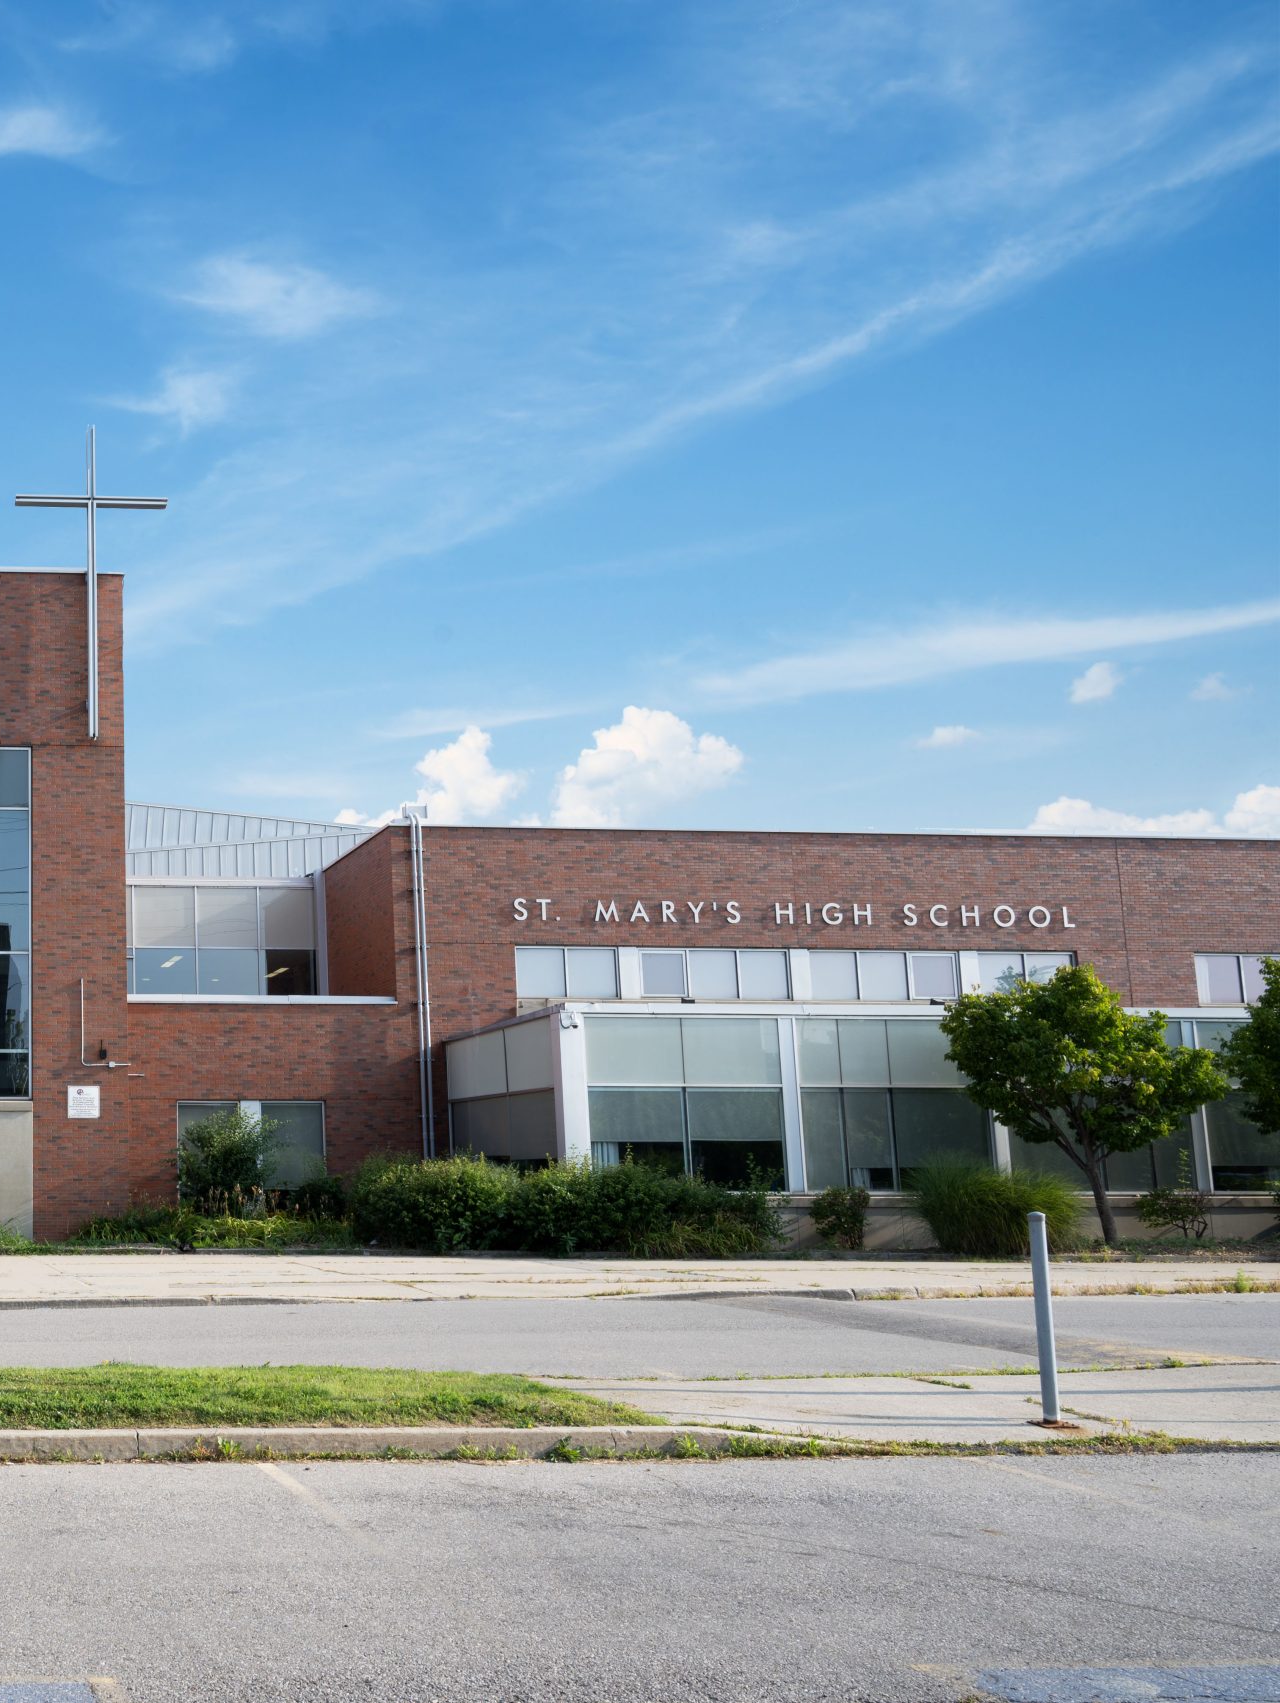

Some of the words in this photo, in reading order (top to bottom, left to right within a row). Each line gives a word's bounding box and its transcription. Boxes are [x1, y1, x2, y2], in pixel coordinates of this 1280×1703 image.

[513, 898, 561, 921] ST.
[594, 899, 741, 924] MARY'S
[775, 902, 872, 925] HIGH
[903, 903, 1076, 928] SCHOOL
